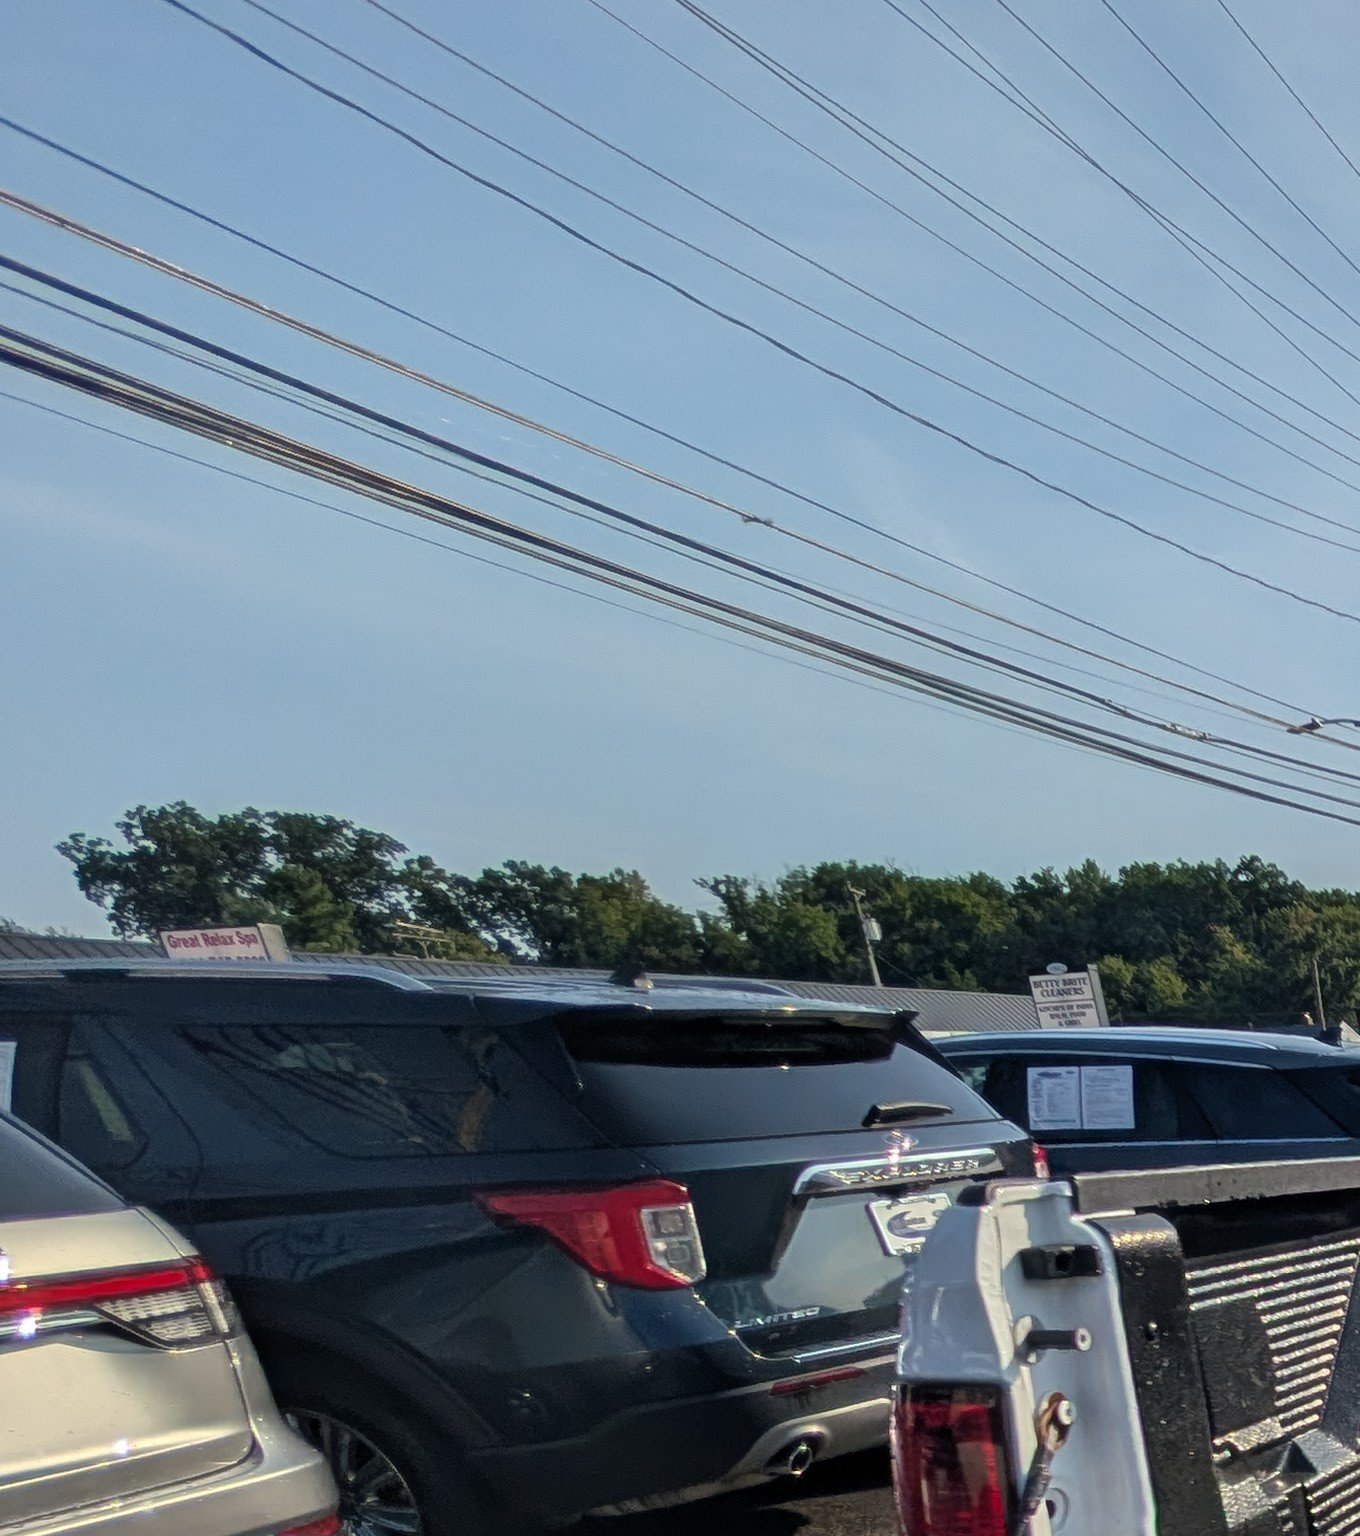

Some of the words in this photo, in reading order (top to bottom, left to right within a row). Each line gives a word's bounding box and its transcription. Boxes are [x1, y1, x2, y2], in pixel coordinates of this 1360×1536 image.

[167, 934, 201, 949] Great
[201, 931, 236, 947] Relax
[236, 930, 259, 947] Spa
[1040, 987, 1085, 998] CLEANERS
[734, 1306, 820, 1329] LIMITED
